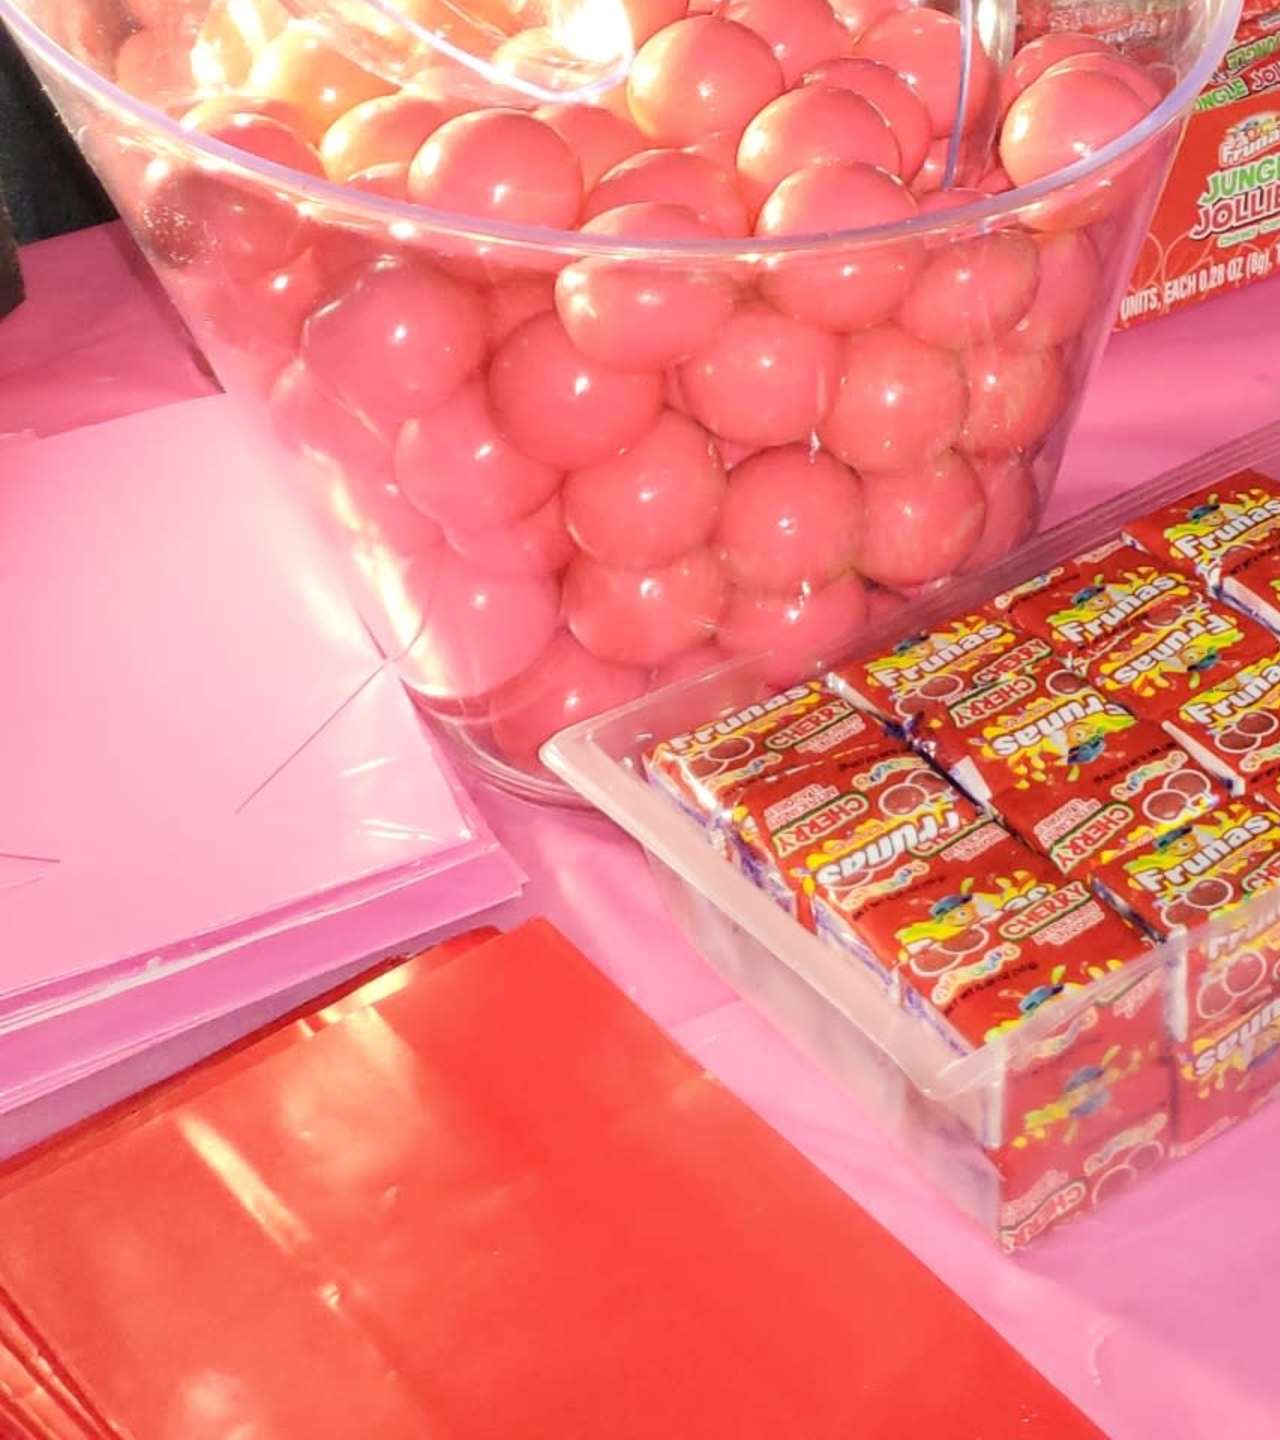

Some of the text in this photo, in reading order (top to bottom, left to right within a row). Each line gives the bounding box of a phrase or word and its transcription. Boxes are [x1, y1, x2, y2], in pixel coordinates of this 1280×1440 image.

[1194, 76, 1249, 111] NGLE
[1163, 275, 1197, 305] EACH
[1199, 264, 1225, 292] 0.28
[1056, 575, 1178, 642] Frunas
[875, 624, 1003, 686] Frunas
[1112, 616, 1233, 683] Frunas
[669, 684, 811, 748] Frunas
[950, 675, 1036, 727] CHERRY
[1050, 804, 1134, 874] CHERRY
[1134, 814, 1273, 893] Frunas
[999, 881, 1091, 940] CHERRY
